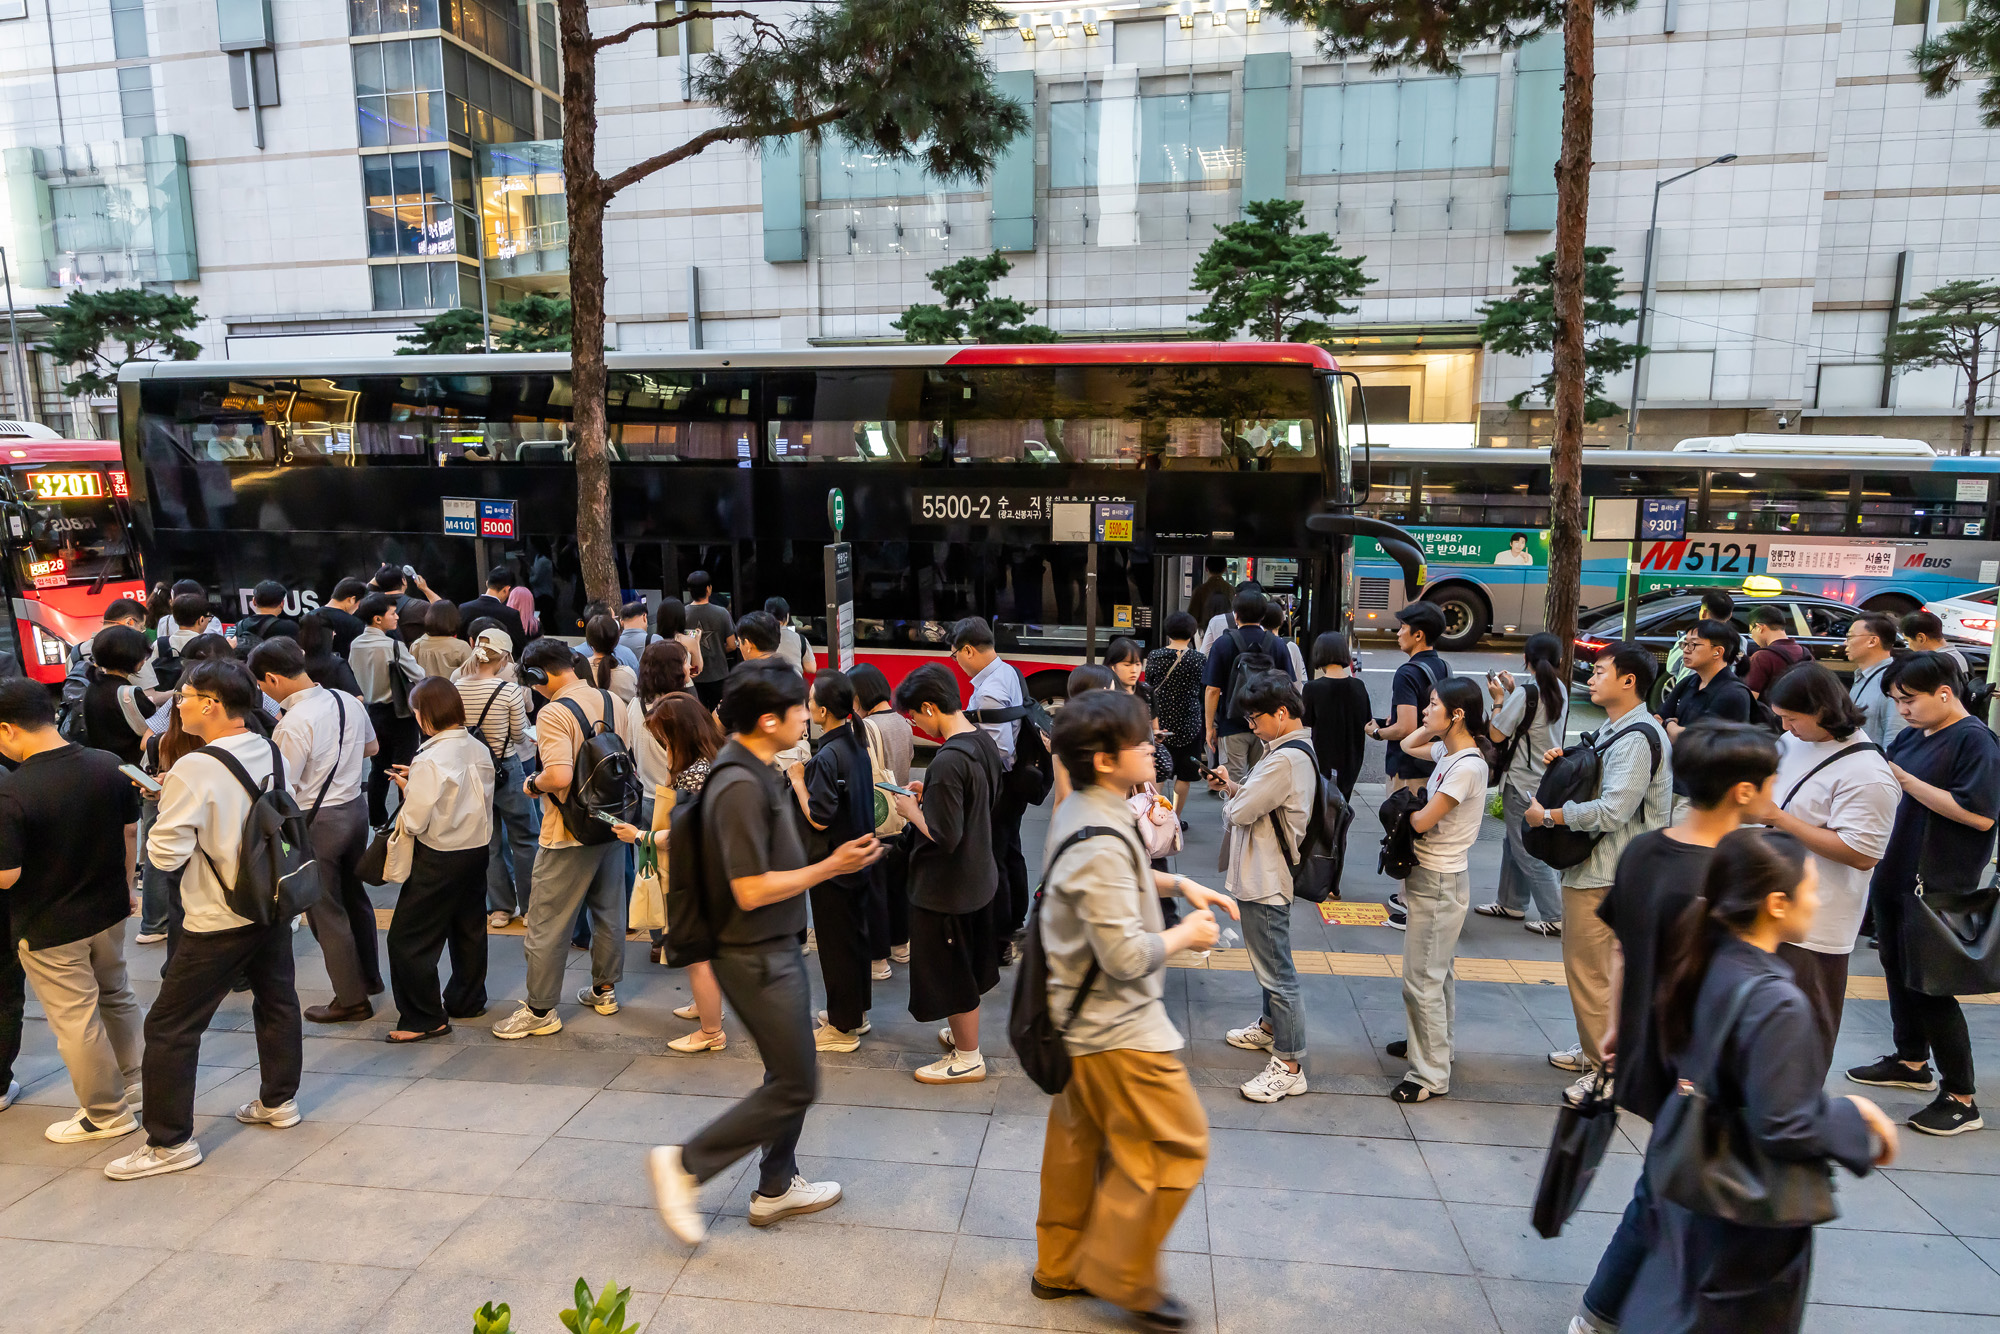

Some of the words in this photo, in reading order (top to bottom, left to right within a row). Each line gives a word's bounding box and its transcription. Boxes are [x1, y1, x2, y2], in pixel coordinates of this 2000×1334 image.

[37, 474, 95, 496] 3201
[922, 495, 991, 519] 5500-2
[445, 520, 475, 530] M4101
[483, 521, 511, 533] 5000
[1109, 522, 1129, 535] 5500-2
[1649, 519, 1677, 531] 9301
[1426, 533, 1463, 543] 받으세요?
[1437, 544, 1481, 557] 받으세요!
[1640, 539, 1757, 572] M5121
[50, 559, 64, 571] 28
[1865, 552, 1891, 565] 서울역
[1903, 553, 1952, 569] MBUS
[239, 588, 320, 616] RUS
